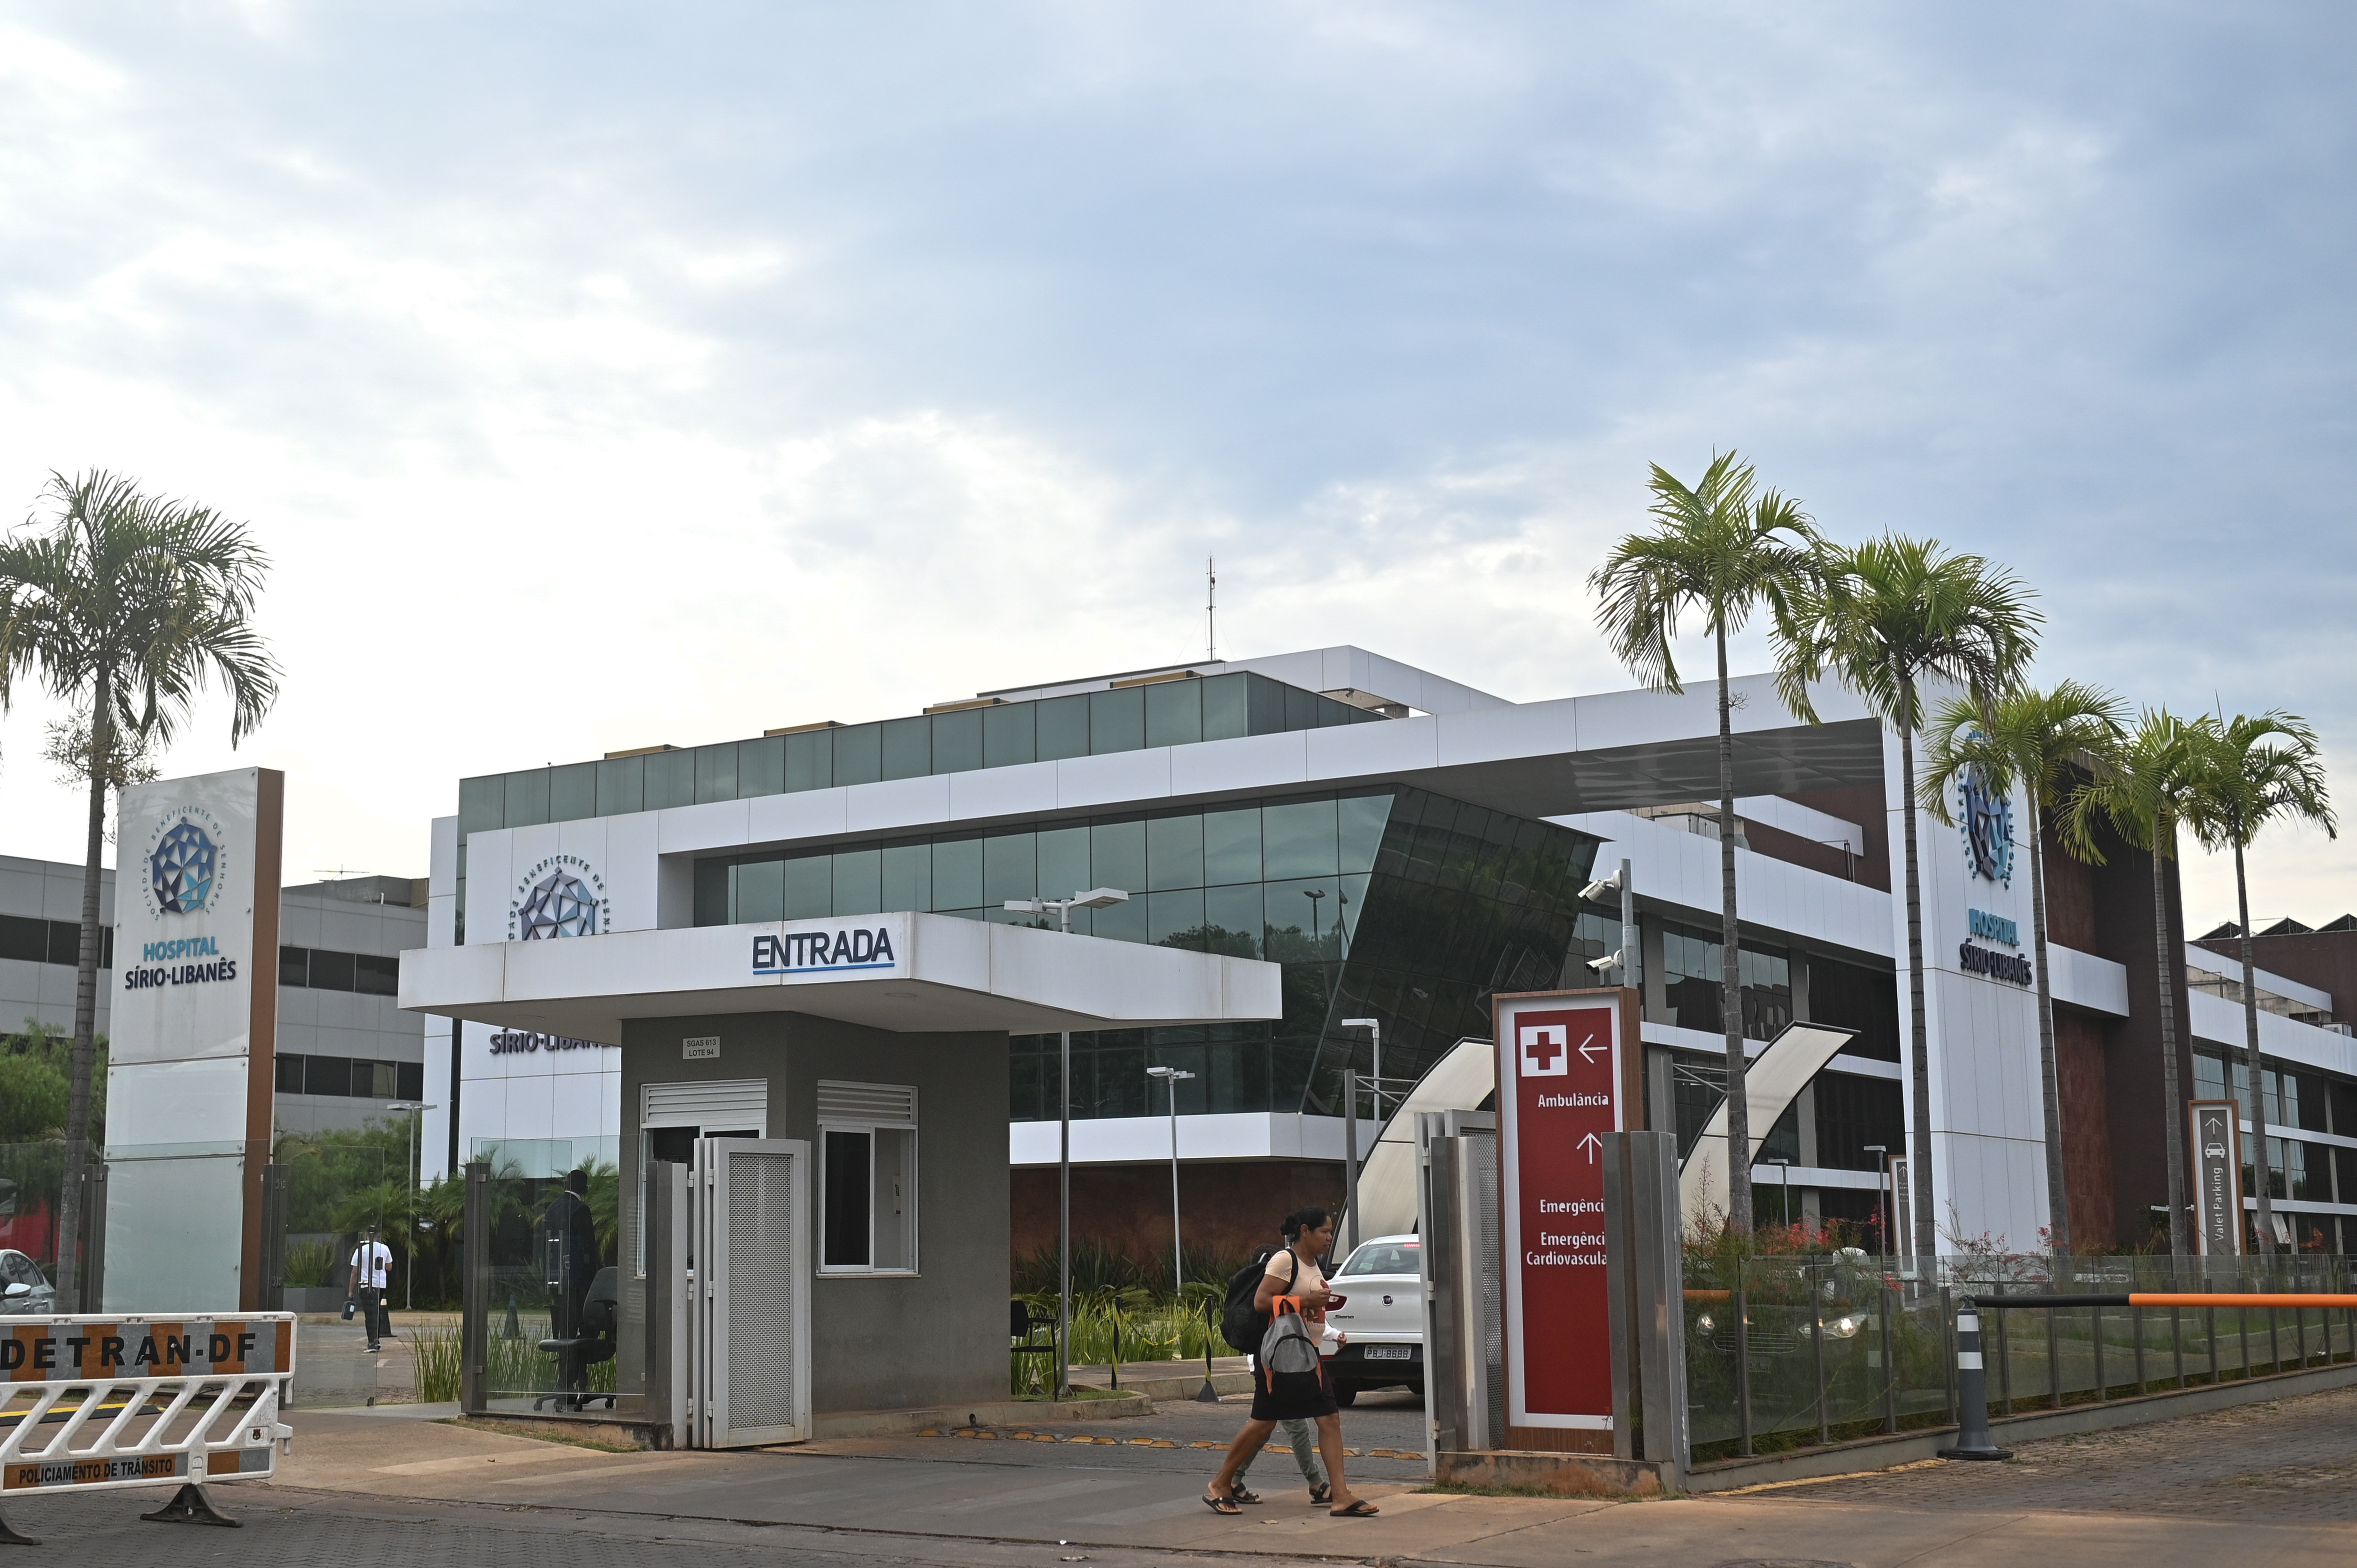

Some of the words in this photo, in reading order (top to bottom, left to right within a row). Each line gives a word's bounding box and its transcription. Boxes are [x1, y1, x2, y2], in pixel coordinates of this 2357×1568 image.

[151, 806, 210, 840] BENEFICENTE
[212, 822, 222, 837] DE
[142, 848, 159, 921] SOCIEDADE
[205, 844, 226, 914] SENHORAS
[1968, 908, 2020, 946] HOSPITAL
[143, 936, 219, 962] HOSPITAL
[753, 928, 894, 968] ENTRADA
[1538, 1092, 1609, 1108] Ambulância
[2212, 1167, 2223, 1210] Parking
[1540, 1198, 1604, 1216] Emergênci
[1541, 1231, 1605, 1249] Emergênci
[2214, 1213, 2224, 1241] Valet
[1526, 1251, 1607, 1266] Cardiovascula
[0, 1333, 256, 1370] DETRAN-DF
[19, 1464, 100, 1484] POLICIAMENTO
[104, 1463, 117, 1478] DE
[120, 1458, 172, 1476] TRÂNSITO
